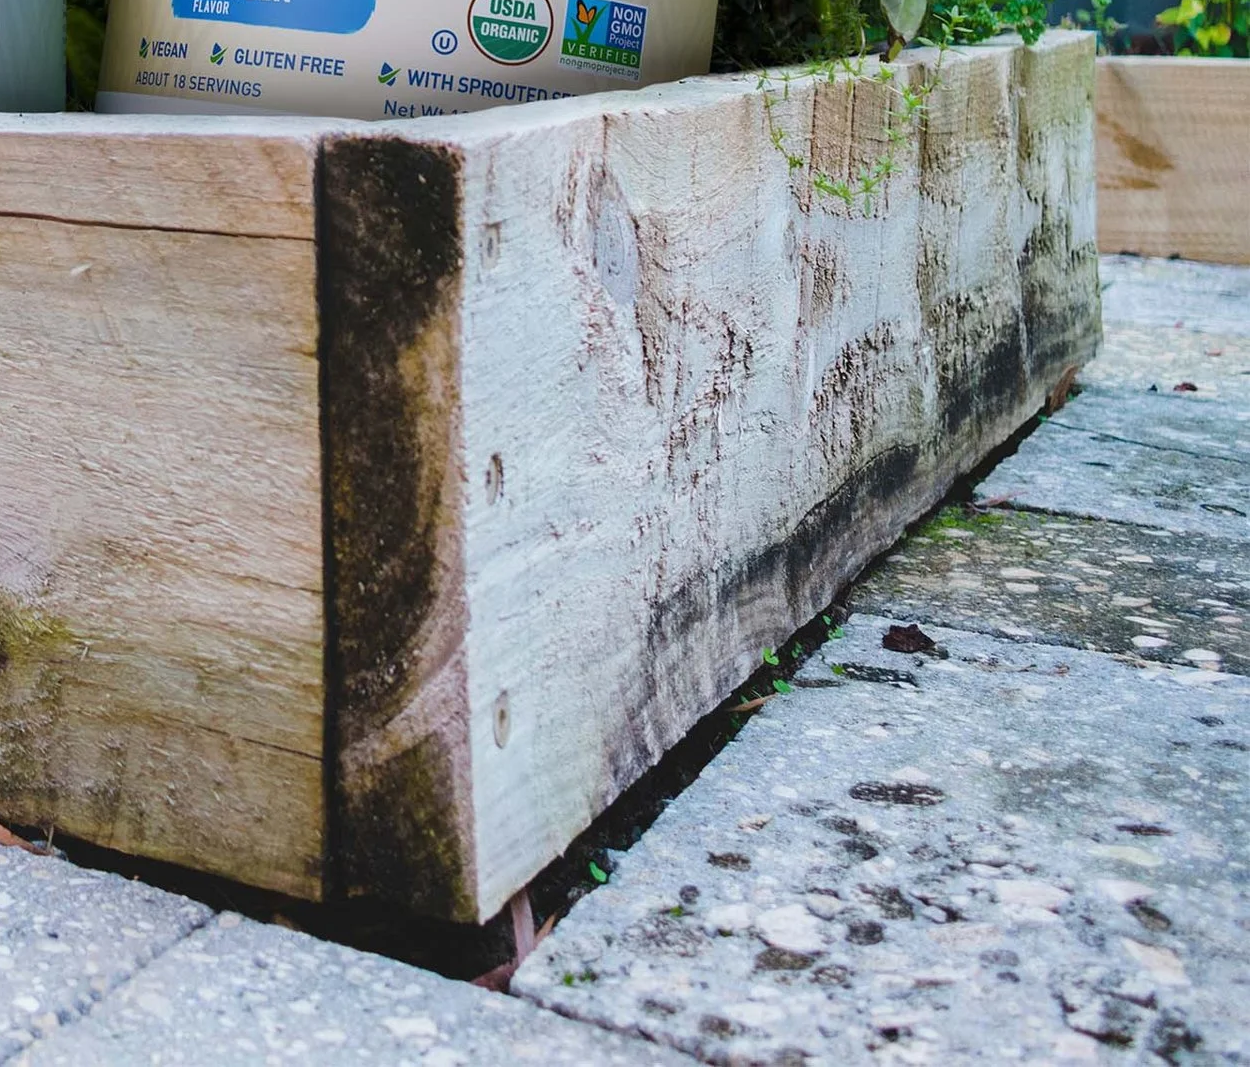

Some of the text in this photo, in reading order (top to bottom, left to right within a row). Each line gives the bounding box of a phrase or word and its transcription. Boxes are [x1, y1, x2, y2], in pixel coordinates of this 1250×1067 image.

[193, 0, 229, 15] FLAVOR
[613, 6, 643, 24] NON
[480, 21, 540, 44] ORGANIC
[611, 20, 642, 38] GMO
[150, 41, 188, 59] VEGAN
[609, 33, 640, 49] Project
[234, 48, 345, 76] GLUTEN FREE
[567, 41, 638, 65] VERIFIED
[559, 56, 639, 81] nongmoproject.org
[136, 71, 262, 98] ABOUT 18 SERVINGS
[407, 69, 453, 92] WITH
[457, 77, 548, 102] SPROUTED
[384, 99, 415, 118] Net
